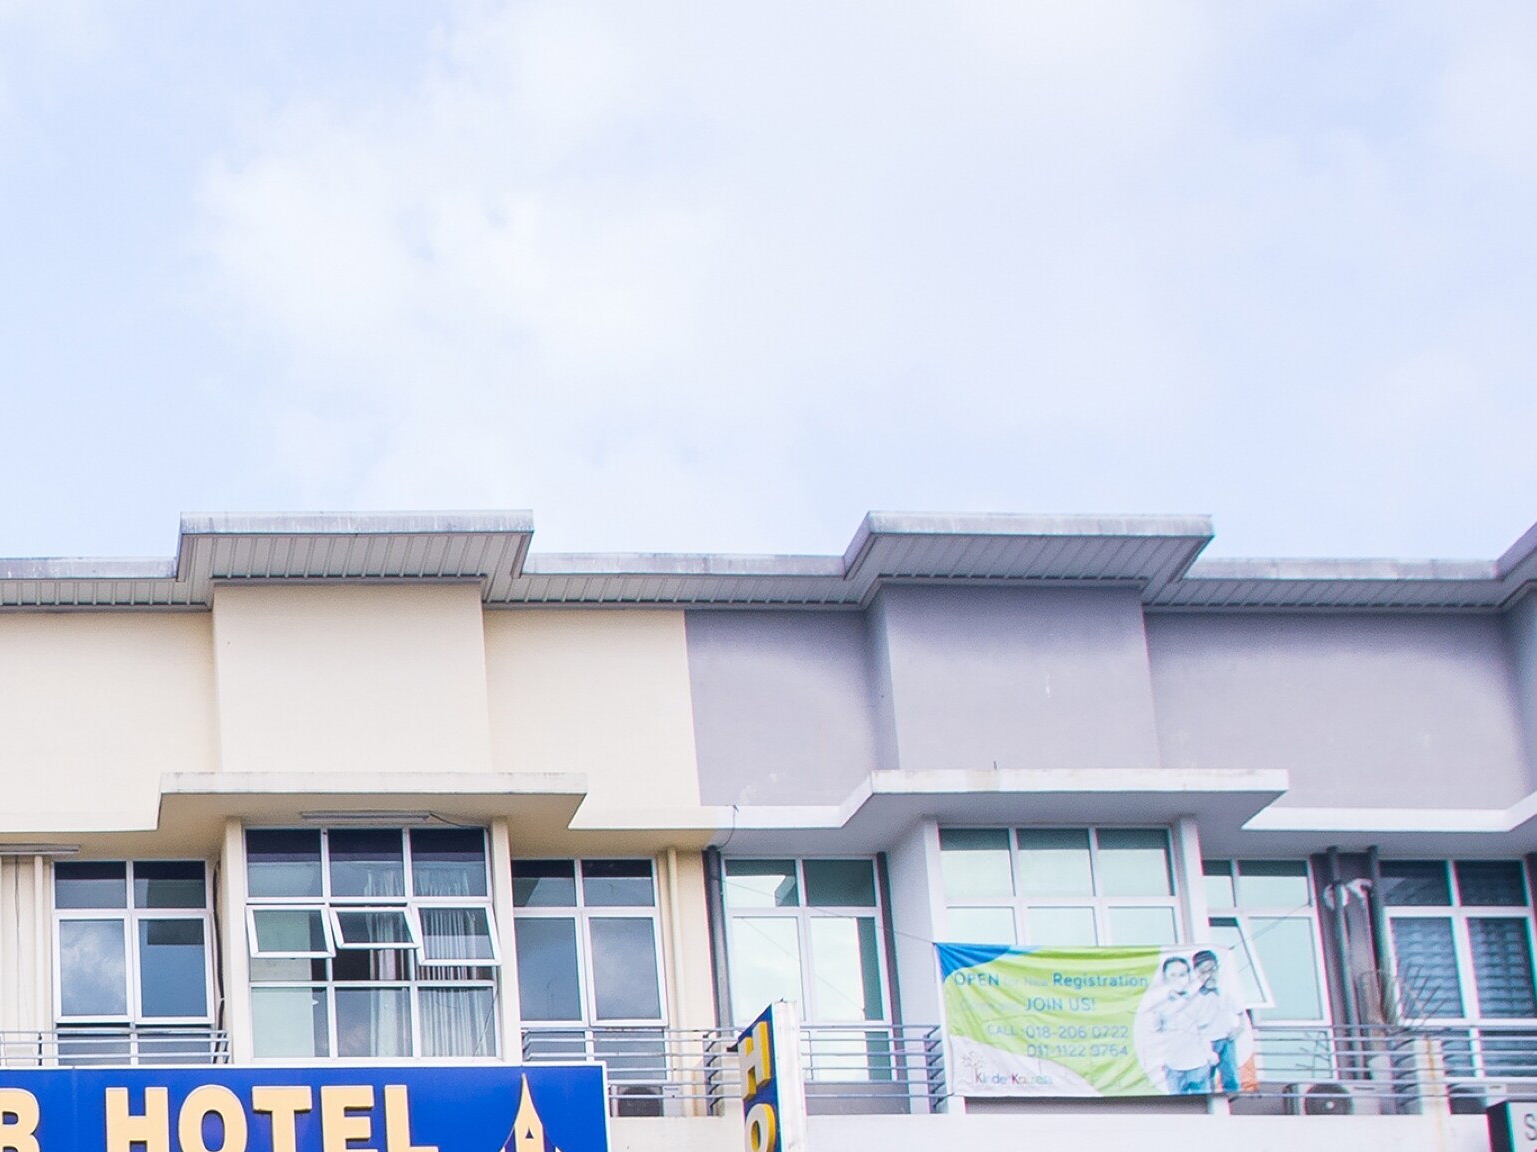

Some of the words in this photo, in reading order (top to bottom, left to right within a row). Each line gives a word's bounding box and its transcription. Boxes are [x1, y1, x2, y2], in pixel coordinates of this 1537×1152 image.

[953, 972, 1000, 987] OPEN
[1053, 972, 1149, 990] Registration
[1026, 998, 1063, 1012] JOIN
[1069, 998, 1097, 1012] US!
